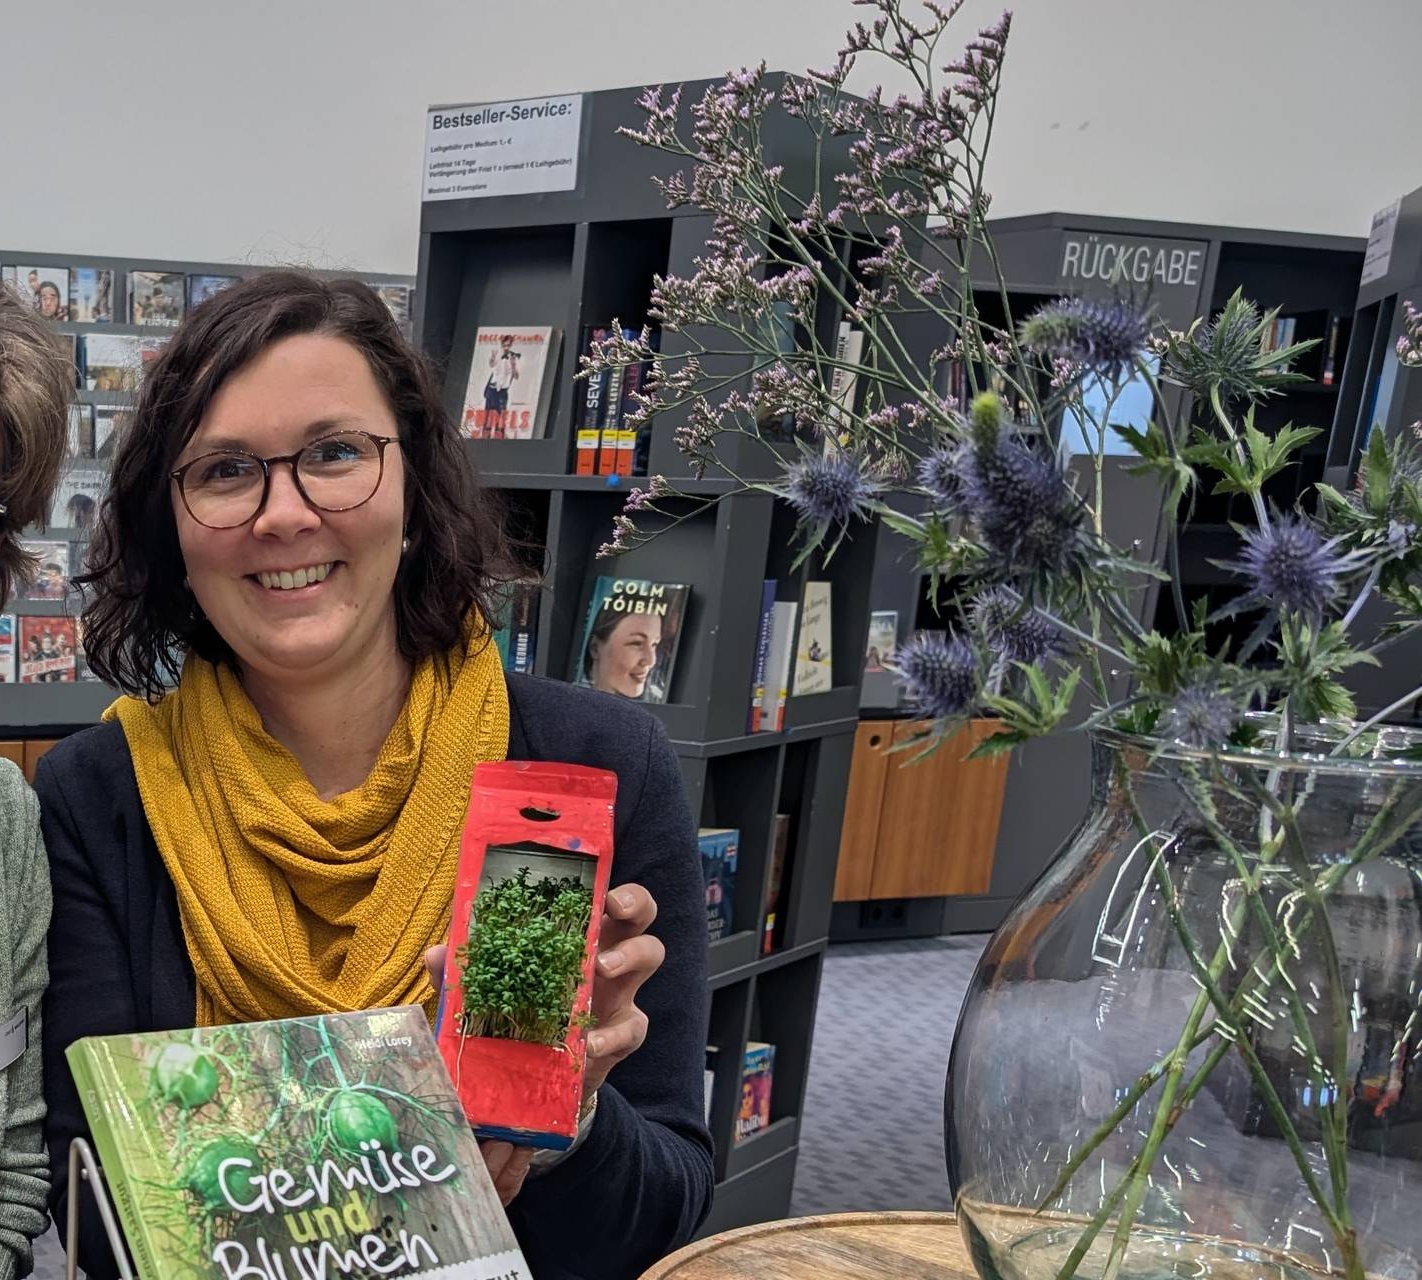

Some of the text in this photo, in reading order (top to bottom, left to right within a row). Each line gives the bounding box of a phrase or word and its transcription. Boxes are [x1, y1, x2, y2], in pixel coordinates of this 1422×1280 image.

[431, 101, 573, 130] Bestseller-Service:
[474, 139, 498, 148] Medium
[462, 159, 476, 168] Tage
[467, 167, 477, 175] der
[1061, 236, 1201, 286] RÜCKGABE
[613, 580, 665, 598] COLM
[603, 595, 668, 616] TÓIBÍN
[359, 1035, 412, 1050] Heidi Lorey
[217, 1140, 456, 1215] Gemüse
[115, 1179, 138, 1237] Saatgut
[283, 1189, 373, 1244] und
[212, 1228, 439, 1280] Blumen
